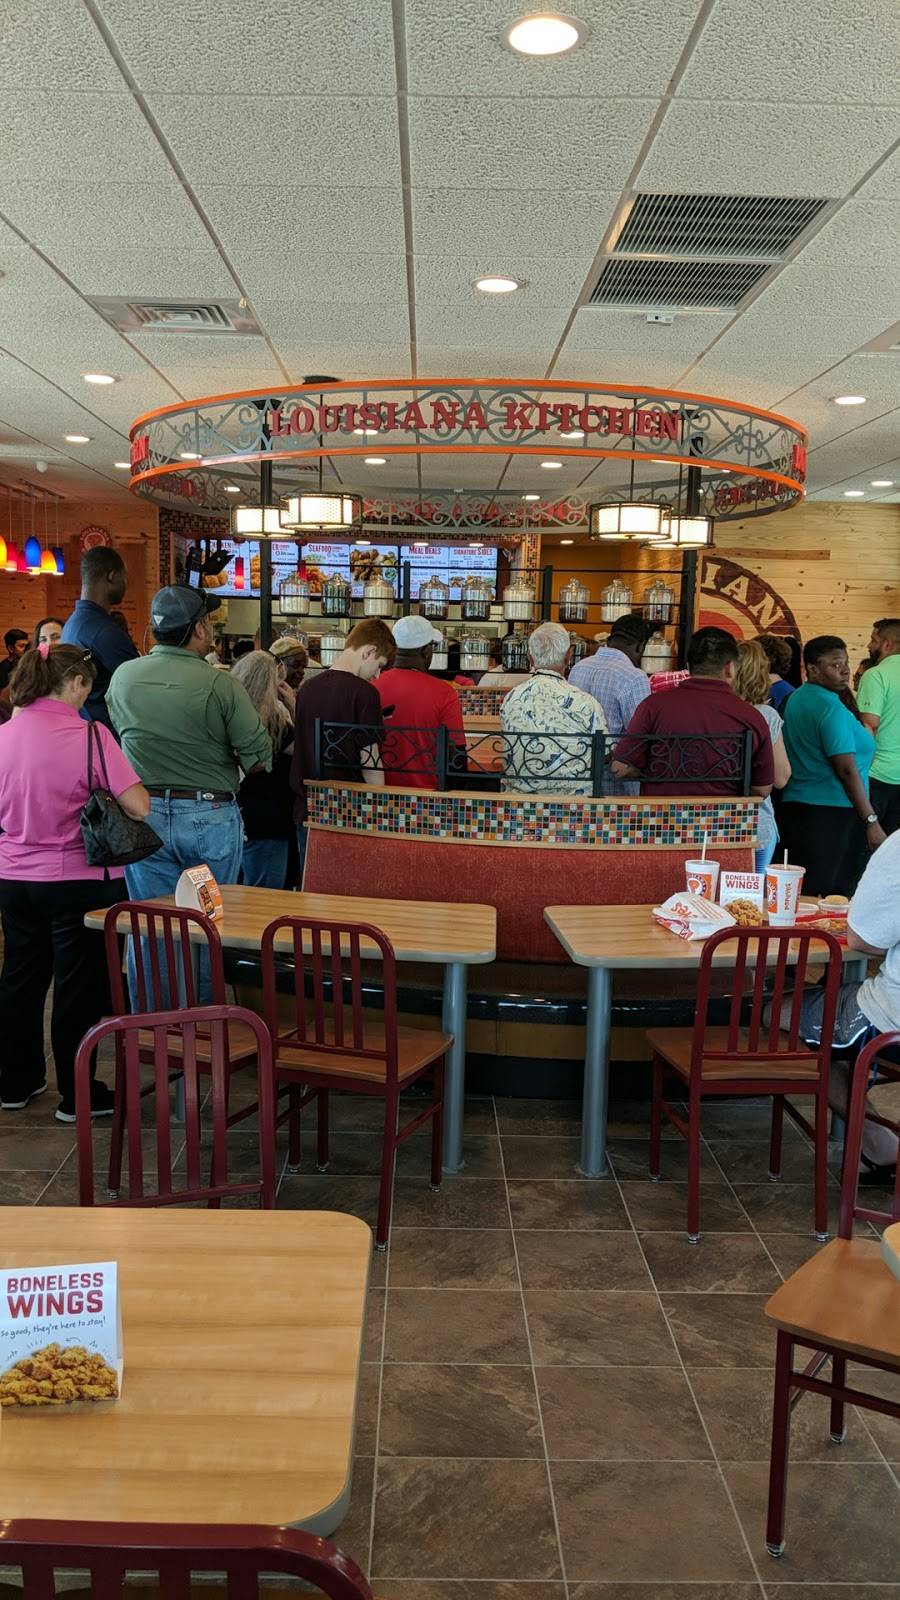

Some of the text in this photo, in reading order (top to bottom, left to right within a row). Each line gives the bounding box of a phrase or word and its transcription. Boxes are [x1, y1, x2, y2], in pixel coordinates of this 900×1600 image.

[269, 401, 682, 440] LOUISIANA KITCHEN
[725, 874, 760, 882] BONELESS
[725, 880, 760, 890] WINGS
[7, 1272, 104, 1294] BONELESS
[6, 1289, 104, 1319] WINGS
[10, 1326, 31, 1339] good,
[33, 1323, 58, 1334] they're
[60, 1321, 76, 1329] here
[78, 1319, 86, 1327] to
[87, 1316, 106, 1328] stay!
